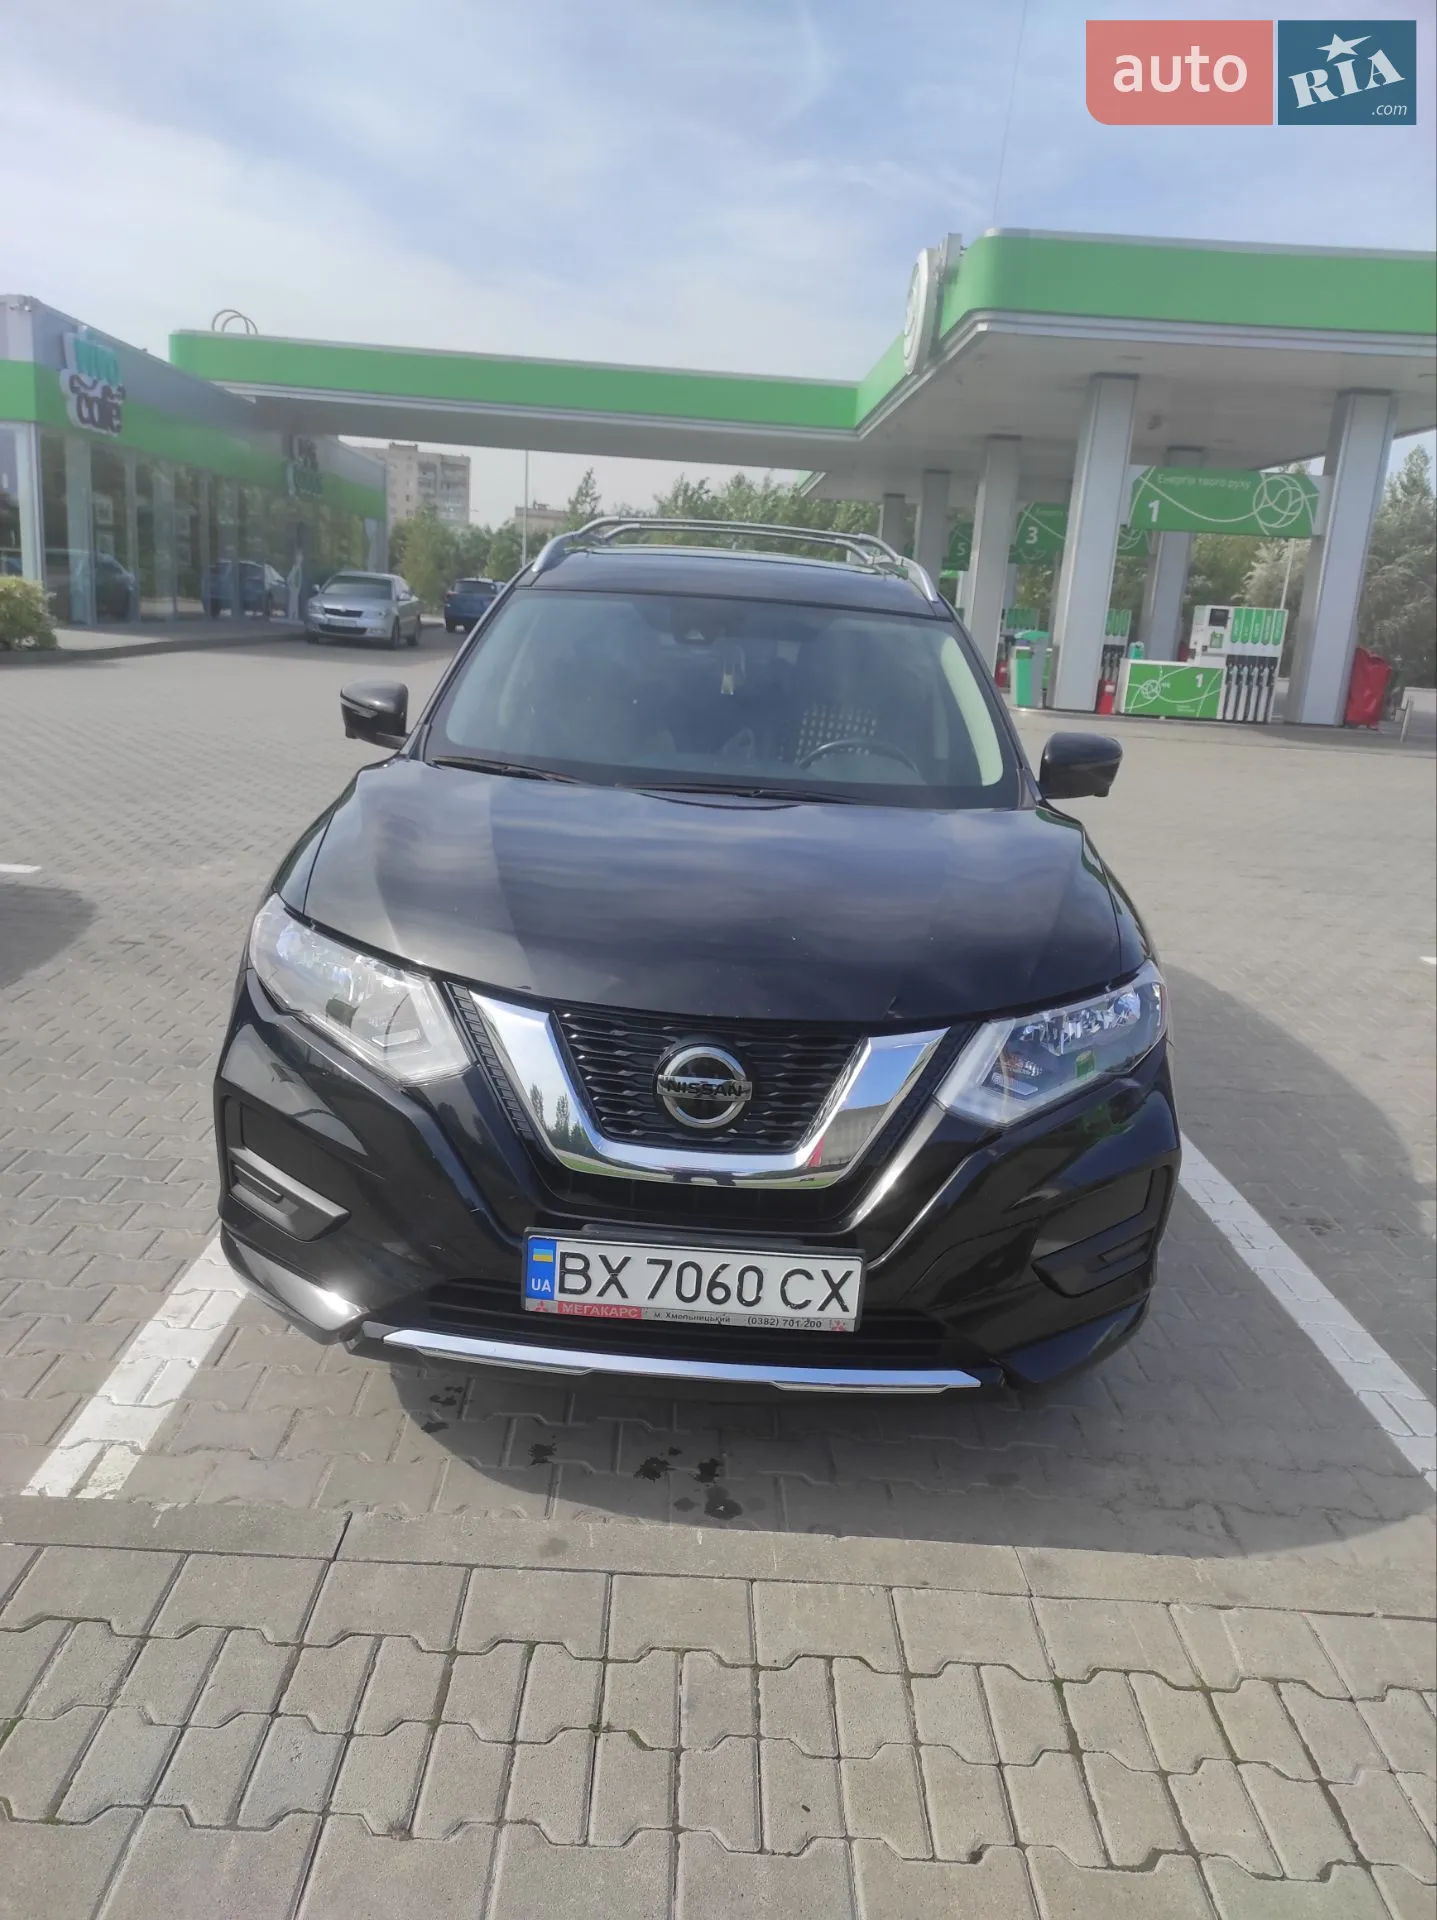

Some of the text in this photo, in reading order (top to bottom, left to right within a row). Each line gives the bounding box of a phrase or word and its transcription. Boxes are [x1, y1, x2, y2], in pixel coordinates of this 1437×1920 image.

[1148, 500, 1160, 522] 1
[1025, 526, 1038, 544] 3
[1195, 673, 1204, 688] 1
[667, 1079, 742, 1097] NISSAN
[531, 1278, 551, 1293] UA
[558, 1251, 854, 1313] BX 7060 CX
[562, 1303, 638, 1318] МЕГАКАРС
[747, 1317, 779, 1327] (0382)
[782, 1318, 800, 1327] 701
[803, 1319, 822, 1328] 200
